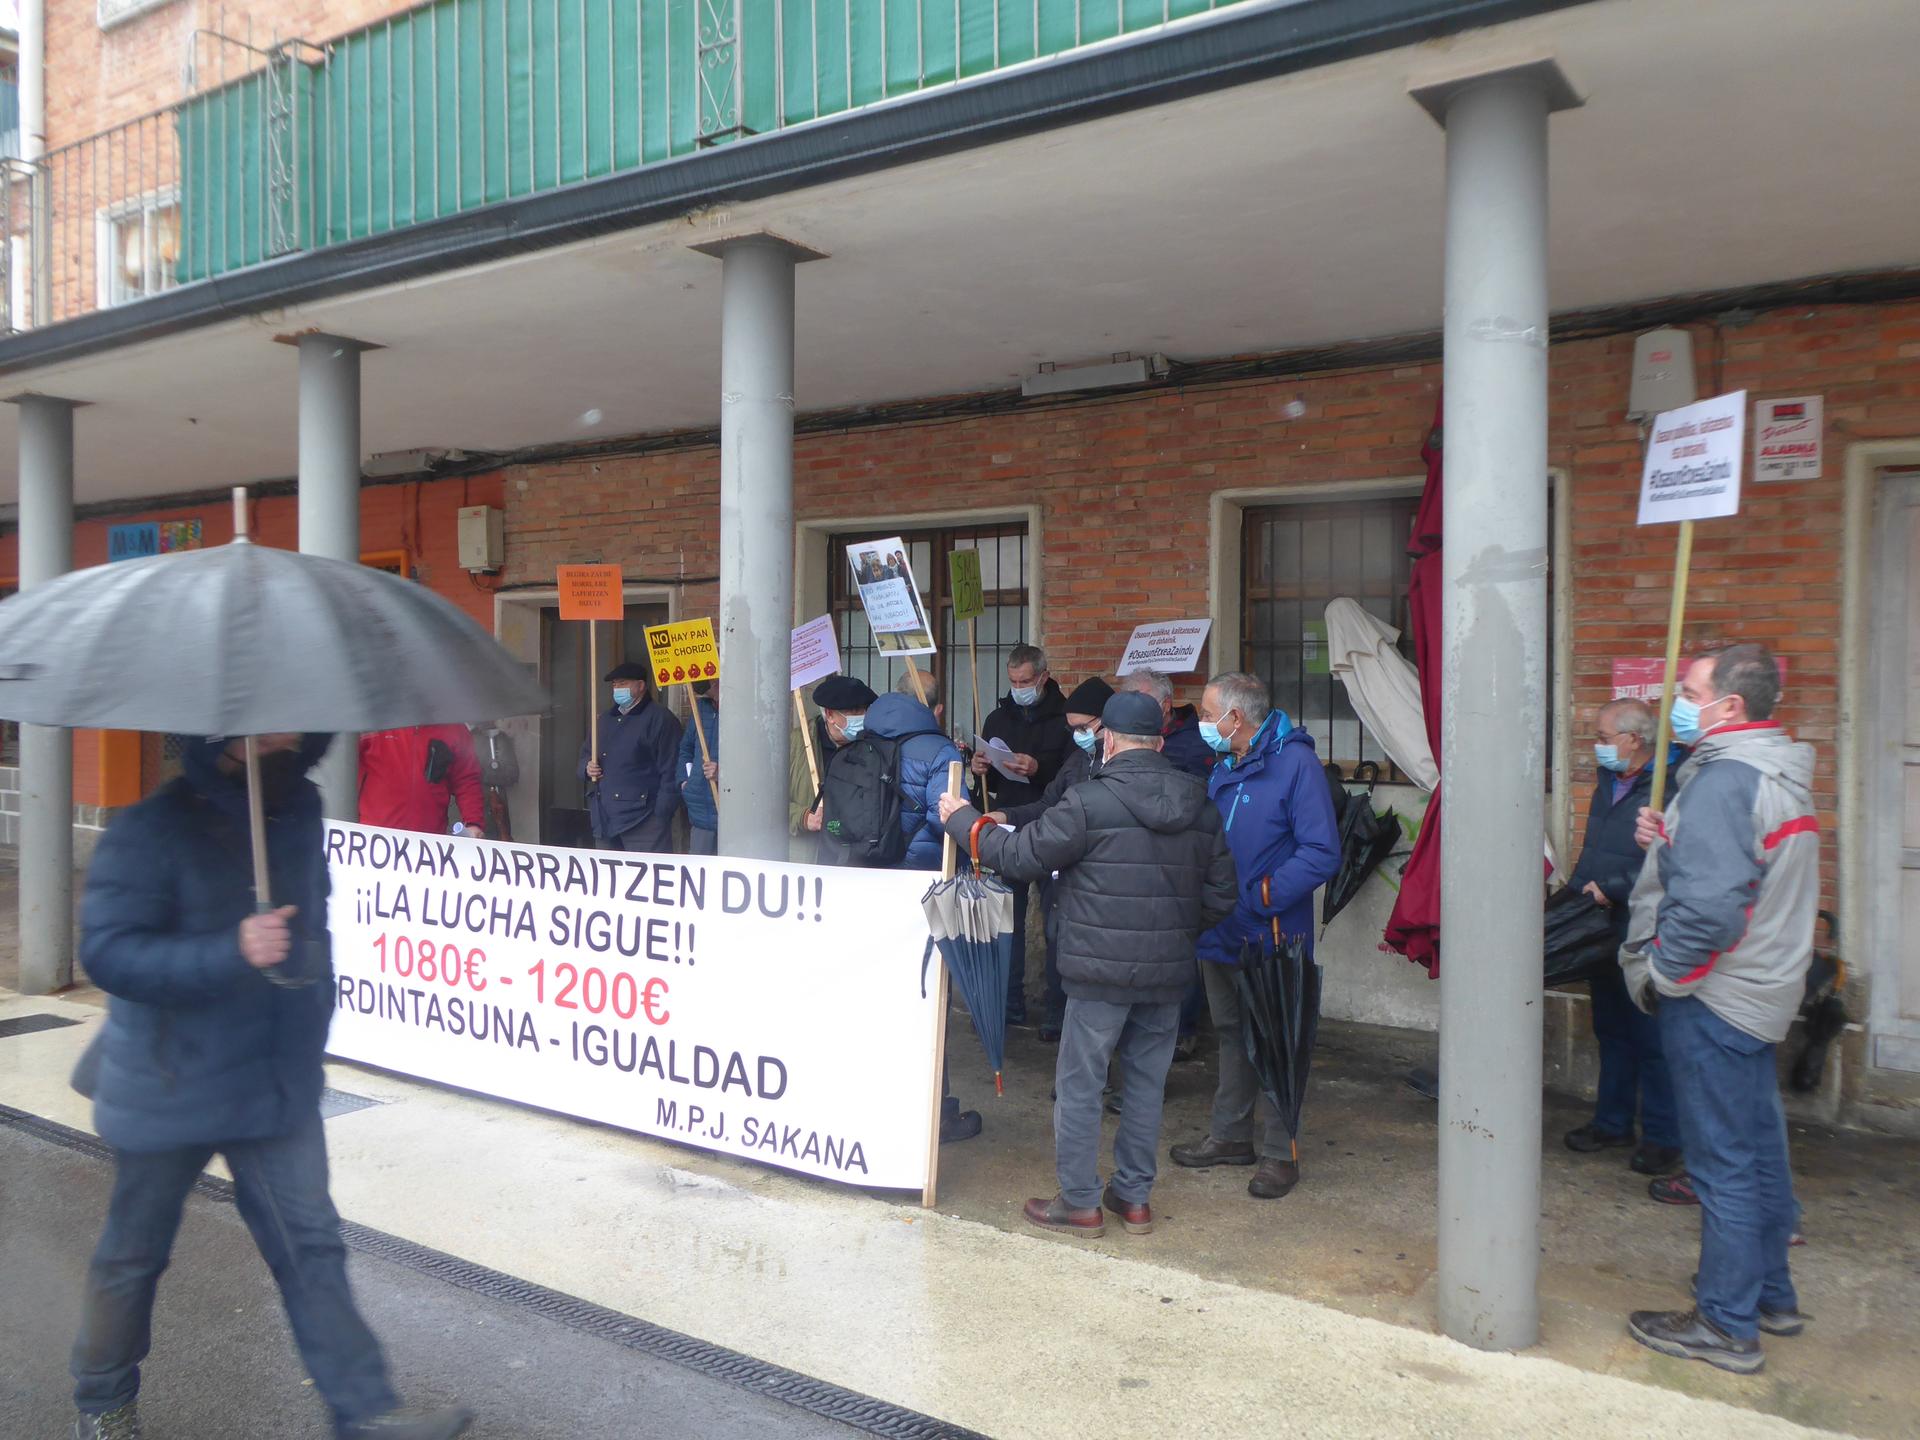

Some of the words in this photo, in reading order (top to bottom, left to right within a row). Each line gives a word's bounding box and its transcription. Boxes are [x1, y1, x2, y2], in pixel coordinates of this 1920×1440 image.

[651, 632, 669, 646] NO
[670, 632, 688, 643] HAY
[690, 629, 708, 640] PAN
[674, 643, 712, 656] CHORIZO
[1128, 645, 1194, 660] #OsasunEtxeaZaindu
[470, 846, 706, 911] JARRAITZEN
[722, 870, 823, 923] DU!!
[357, 881, 411, 925] ¡¡LA
[422, 887, 537, 942] LUCHA
[549, 905, 696, 967] SIGUE!!
[373, 932, 487, 992] 1080€
[500, 976, 513, 985] -
[528, 958, 670, 1026] 1200€
[572, 1020, 788, 1100] IGUALDAD
[656, 1097, 729, 1142] M.P.J.
[741, 1117, 868, 1175] SAKANA
